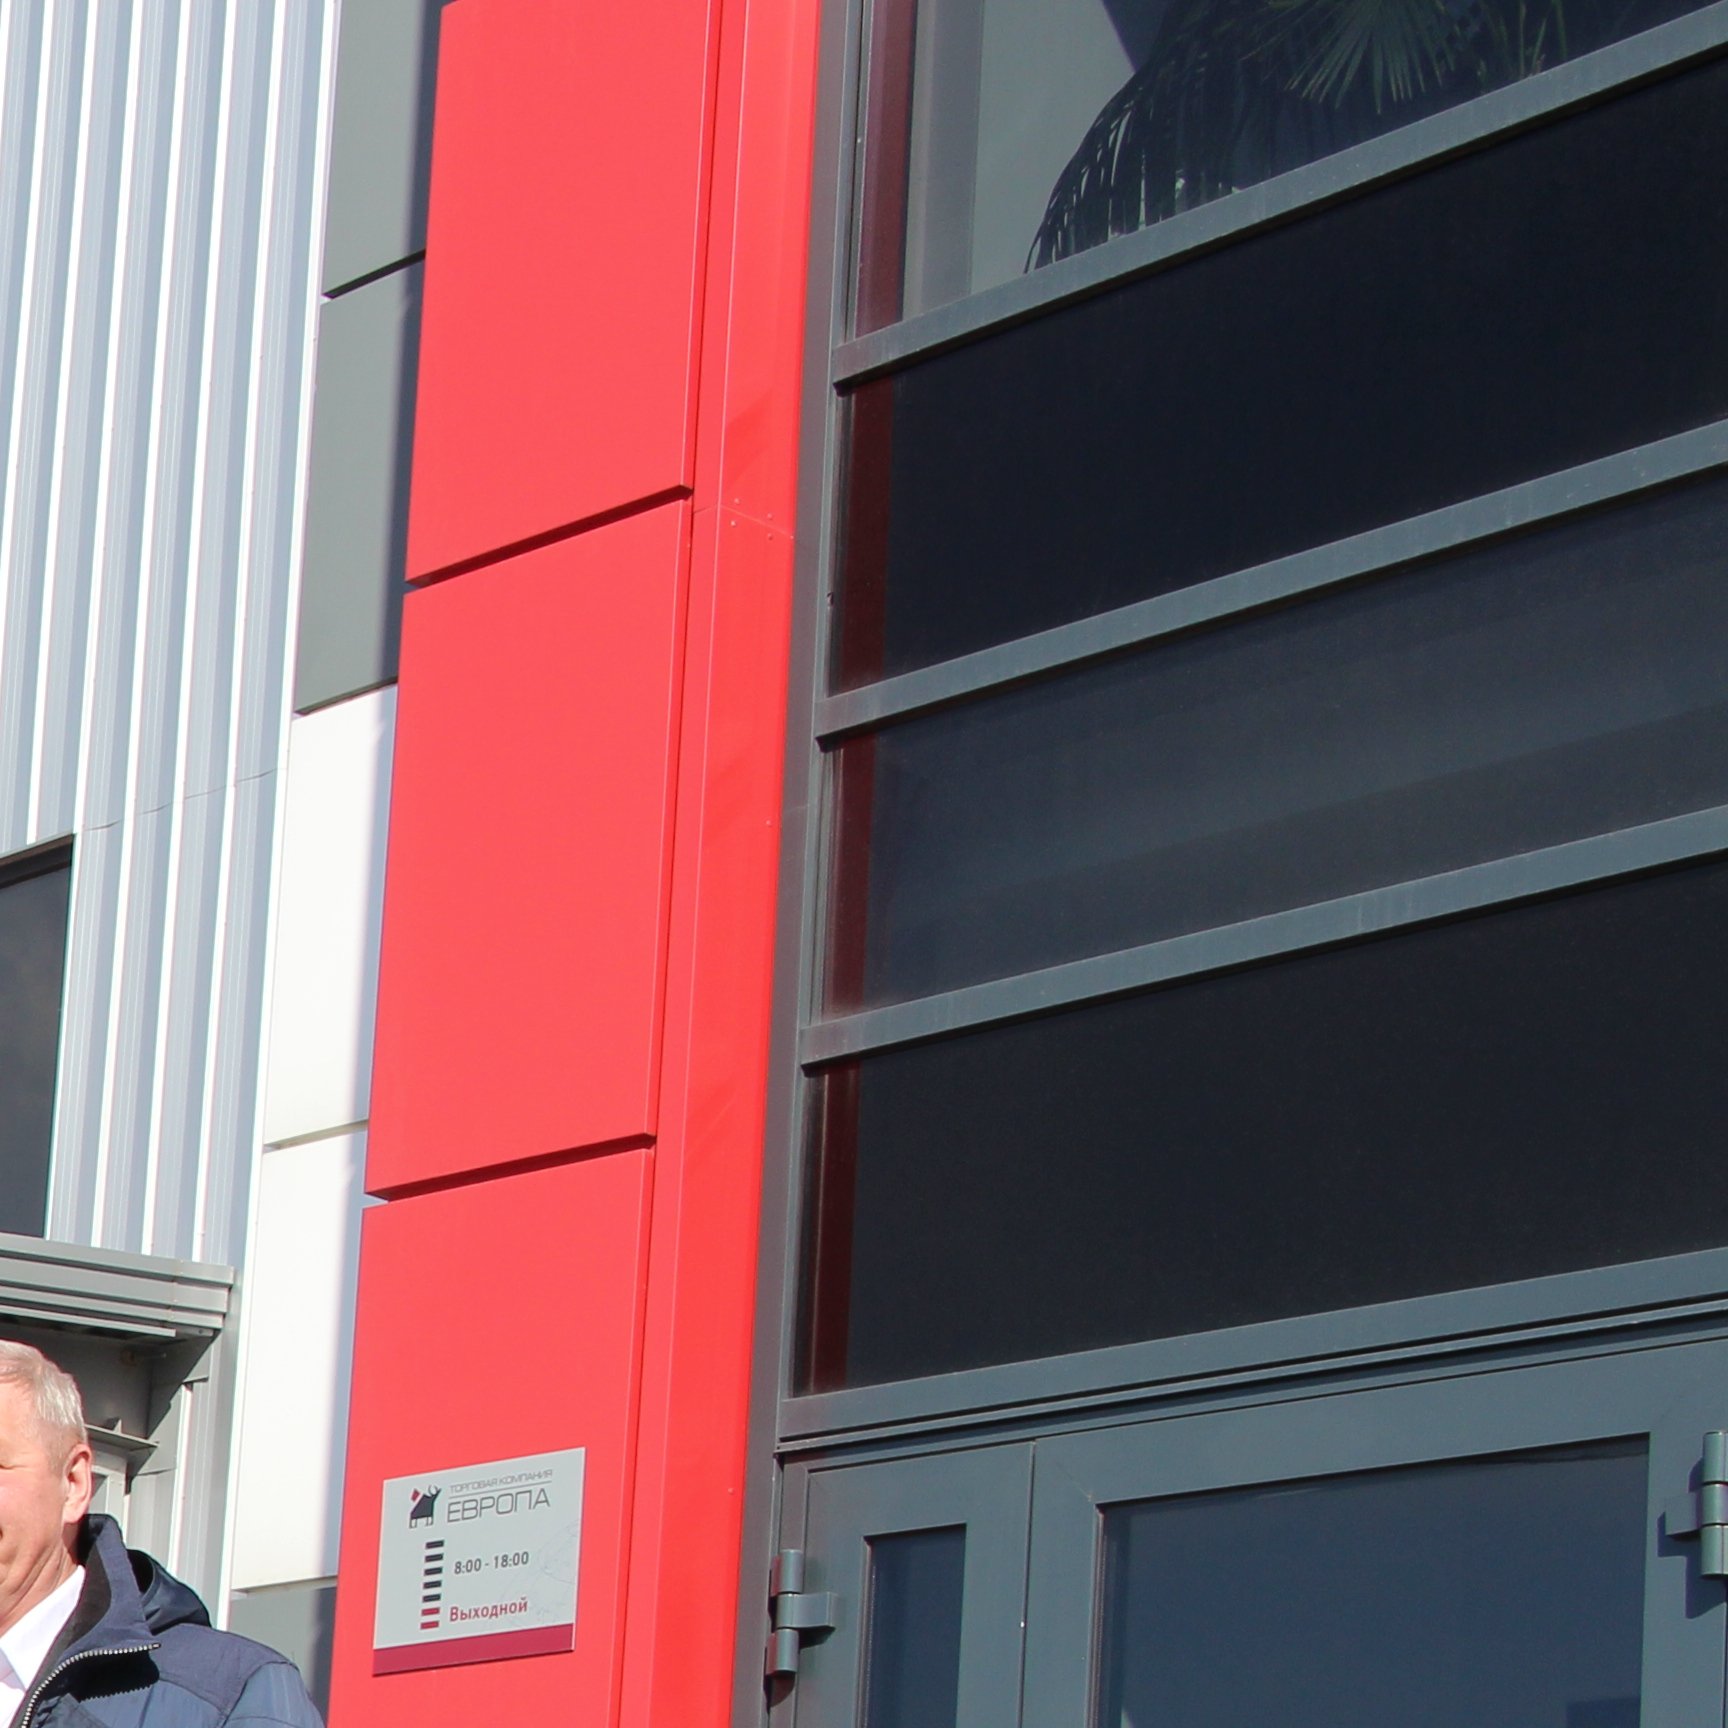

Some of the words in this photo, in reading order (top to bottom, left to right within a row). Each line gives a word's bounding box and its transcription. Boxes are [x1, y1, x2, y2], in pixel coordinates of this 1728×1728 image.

[449, 1478, 498, 1494] ТОРГОВАЯ
[499, 1469, 552, 1484] КОМПАНИЯ
[447, 1488, 550, 1523] ЕВРОПА
[454, 1558, 482, 1575] 8:00
[493, 1551, 530, 1569] 18:00
[449, 1596, 529, 1622] Выходной
